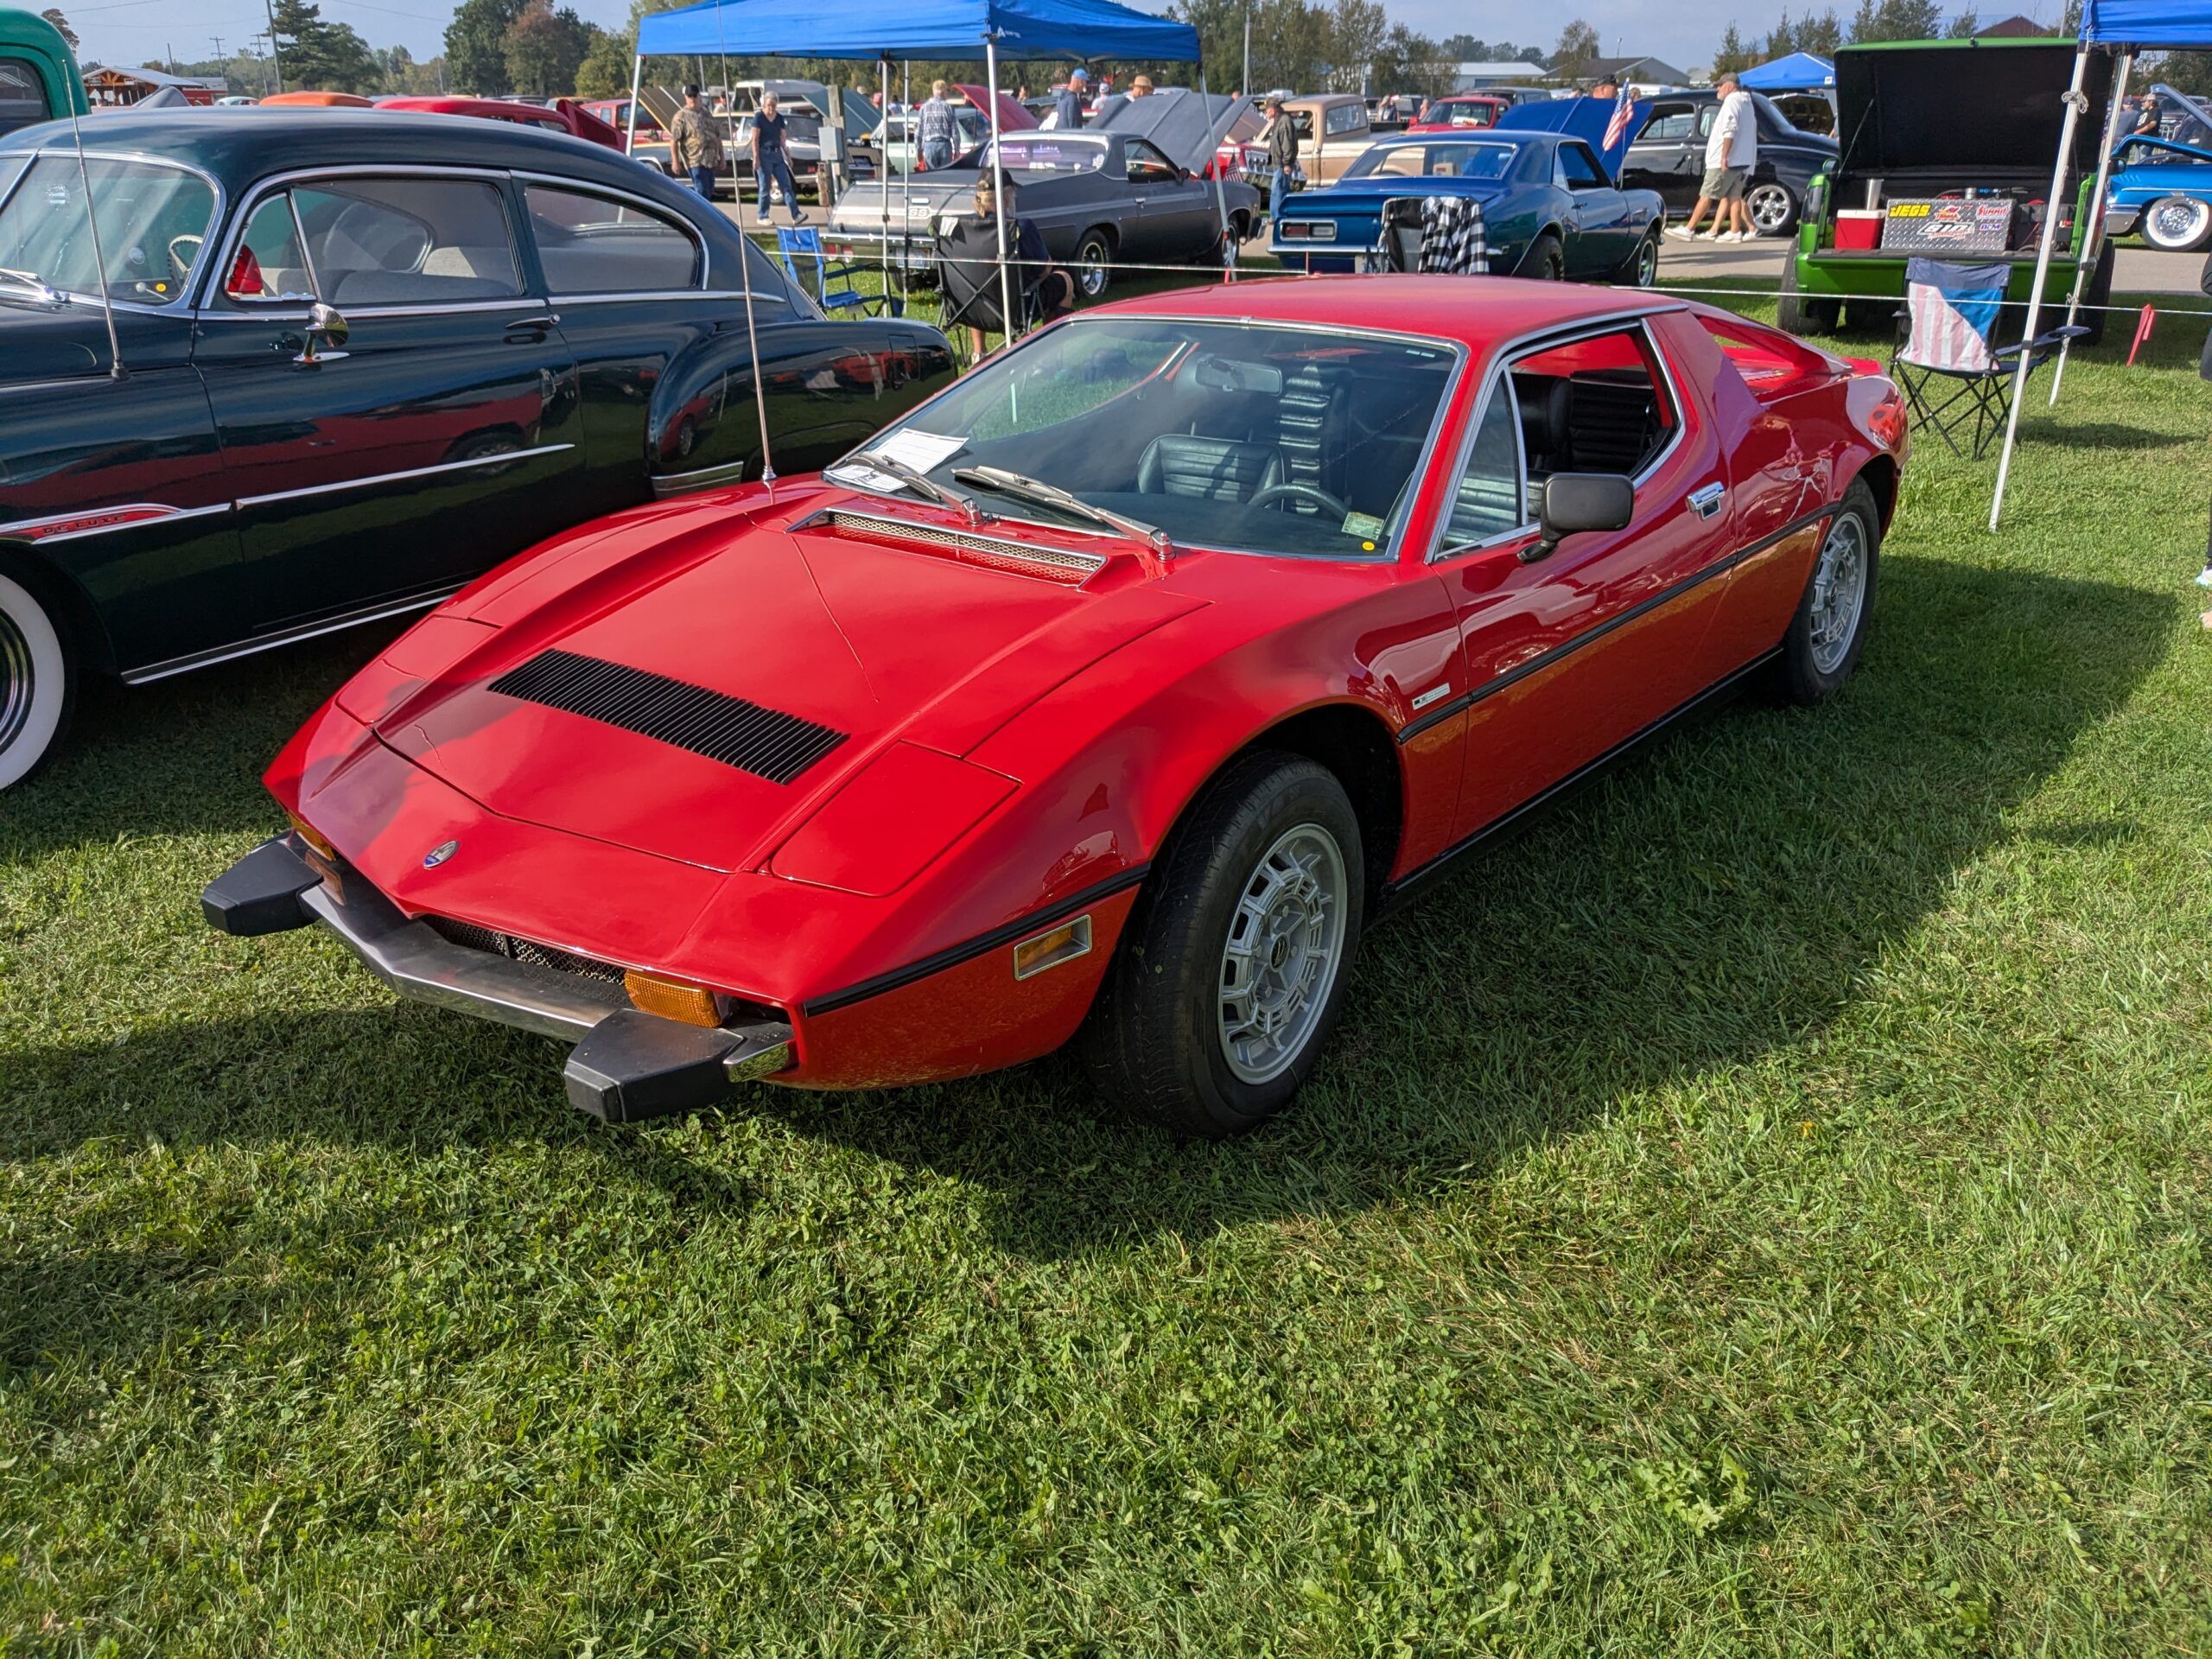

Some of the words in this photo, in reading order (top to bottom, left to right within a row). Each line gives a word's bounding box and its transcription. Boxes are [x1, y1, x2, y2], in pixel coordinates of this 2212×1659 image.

[909, 208, 929, 217] SS
[1889, 205, 1931, 217] JEGS
[42, 524, 69, 534] DE
[75, 513, 126, 528] LUXE
